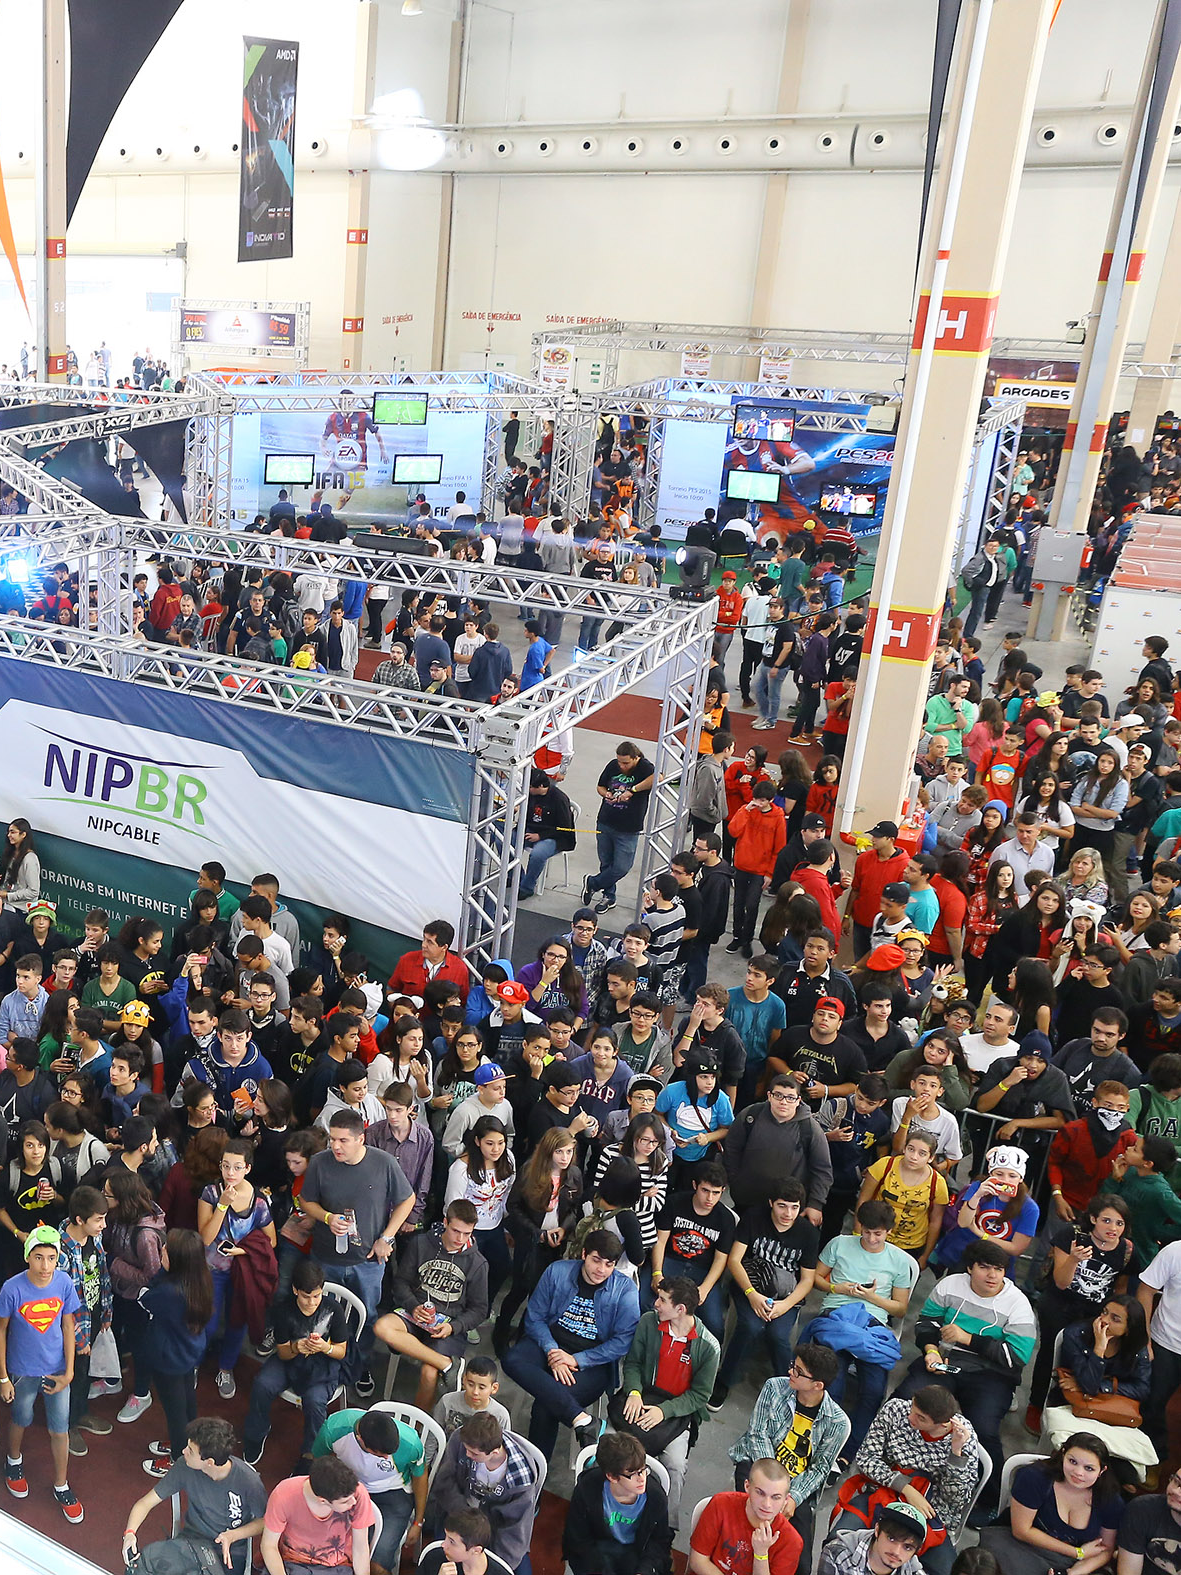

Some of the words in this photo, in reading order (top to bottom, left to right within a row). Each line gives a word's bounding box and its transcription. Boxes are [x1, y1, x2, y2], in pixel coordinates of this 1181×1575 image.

[57, 243, 63, 254] E
[462, 310, 477, 320] SAÍDA
[478, 312, 486, 320] DE
[487, 311, 522, 322] EMERGÊNCIA
[546, 314, 565, 323] SAÍDA
[566, 316, 575, 324] DE
[935, 309, 968, 340] H
[57, 359, 64, 370] E
[105, 415, 130, 428] XYZ
[338, 446, 357, 457] EA
[836, 448, 894, 461] PES20
[304, 472, 344, 490] IFA
[347, 472, 366, 490] 15
[434, 507, 450, 517] FIF
[883, 619, 911, 648] H
[45, 742, 209, 826] NIPBR
[87, 815, 161, 847] NIPCABLE
[40, 868, 95, 893] ORATIVAS
[98, 885, 115, 898] EM
[118, 890, 177, 917] INTERNET
[180, 906, 188, 919] E
[793, 1045, 838, 1076] METALLICA
[673, 1216, 694, 1230] SYSTEM
[705, 1228, 721, 1242] DOWN
